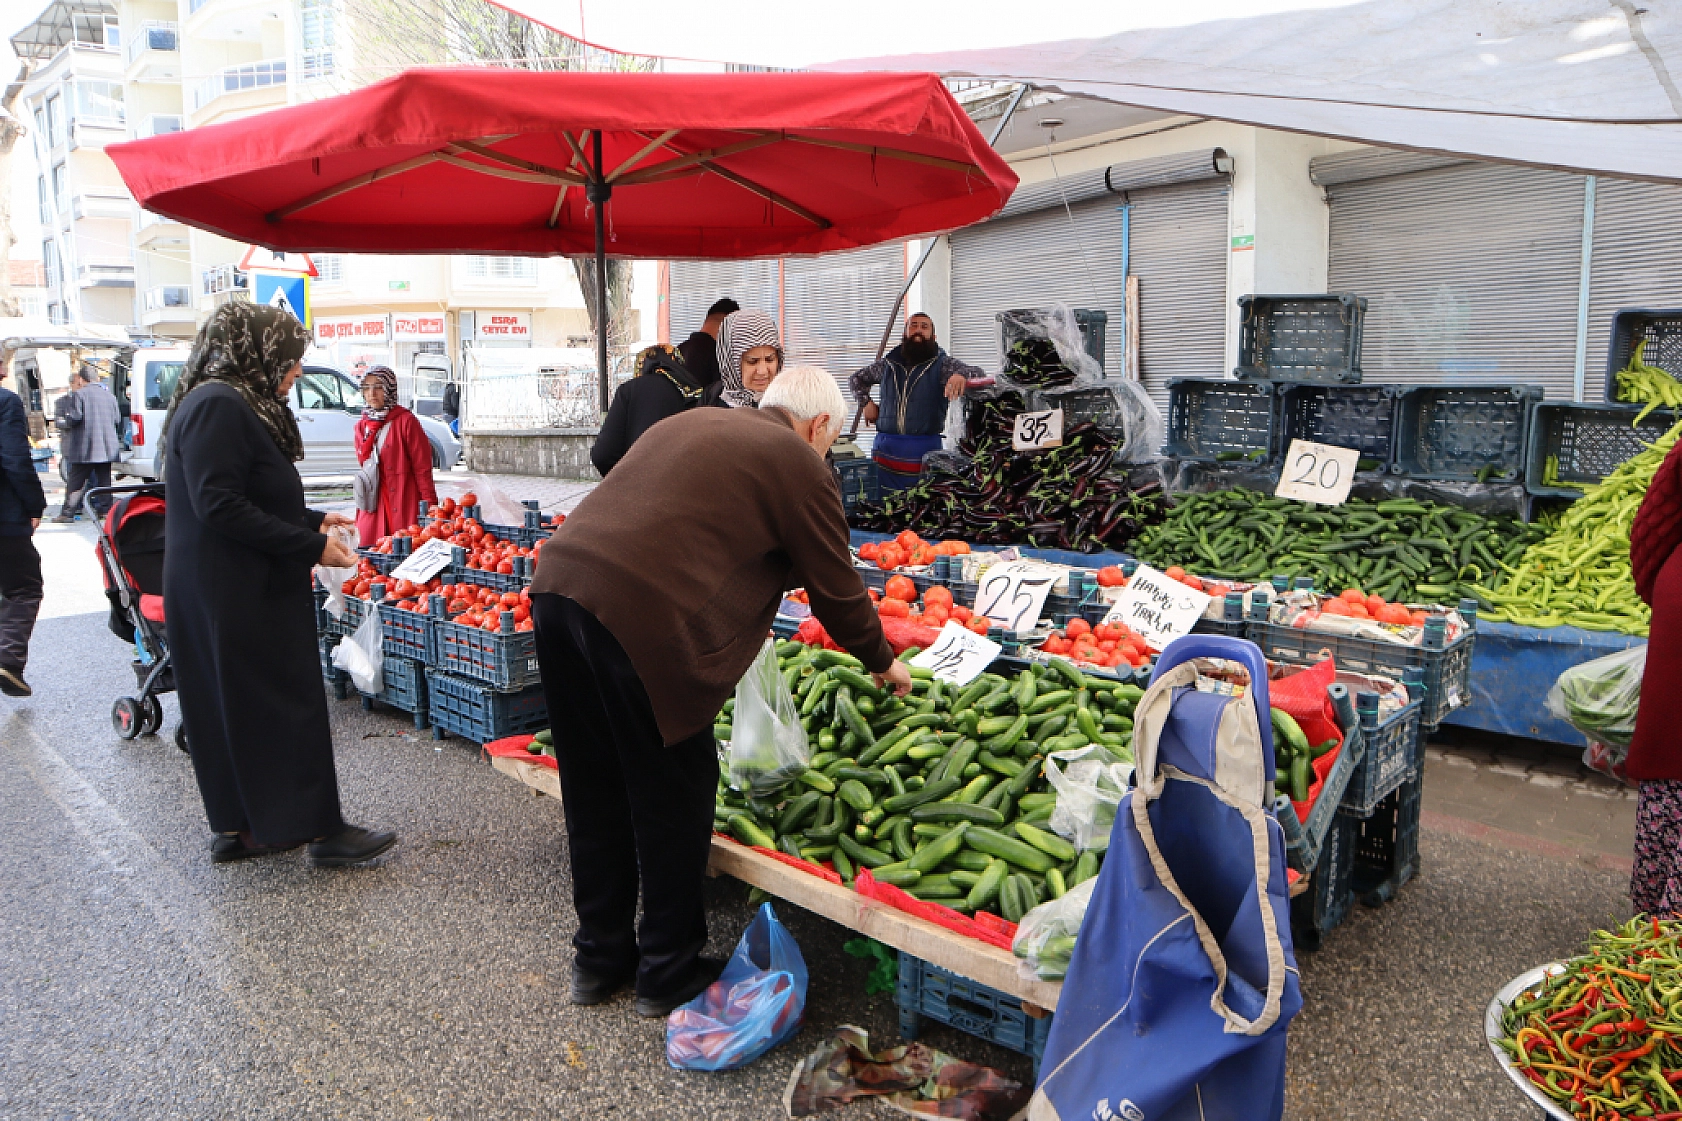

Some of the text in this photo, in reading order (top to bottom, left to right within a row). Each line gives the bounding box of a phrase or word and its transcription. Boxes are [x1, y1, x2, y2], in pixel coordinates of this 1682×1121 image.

[1019, 411, 1054, 446] 35
[1290, 451, 1340, 490] 20
[981, 574, 1052, 631] 25
